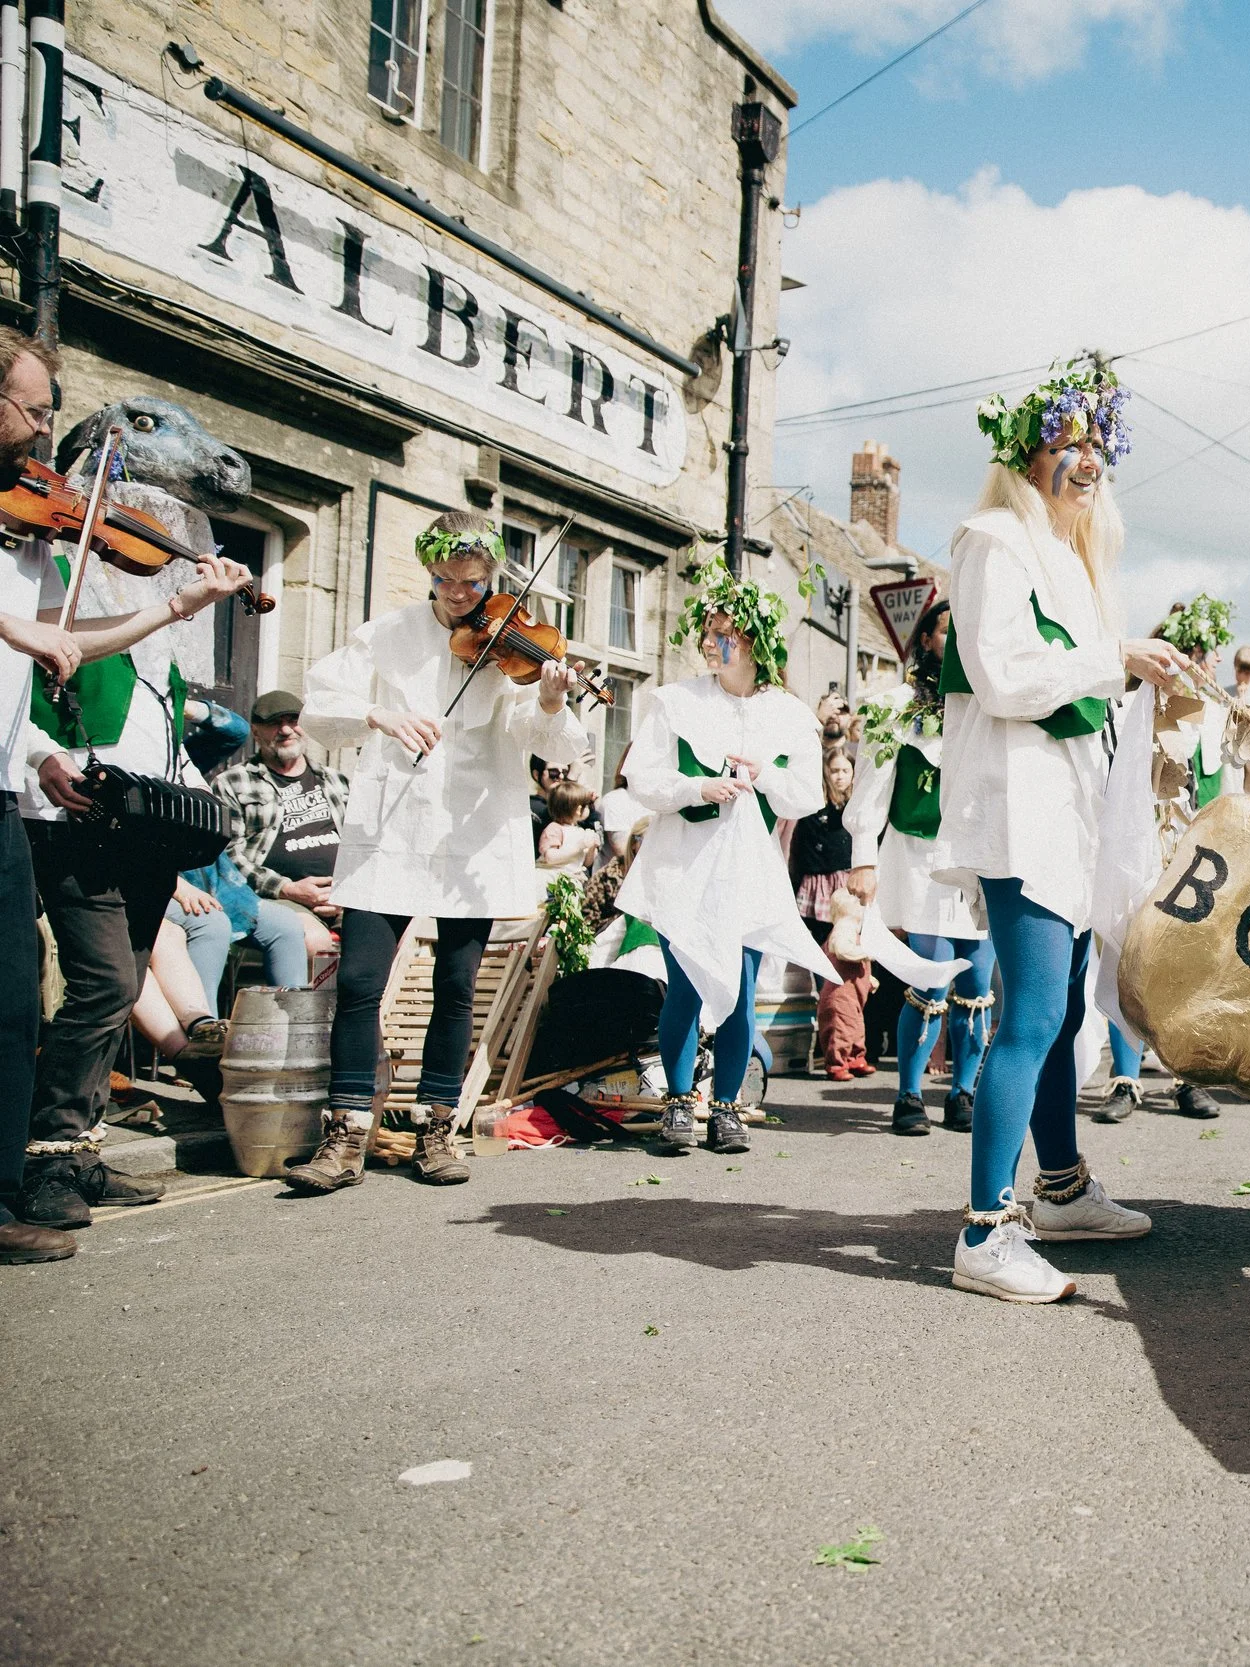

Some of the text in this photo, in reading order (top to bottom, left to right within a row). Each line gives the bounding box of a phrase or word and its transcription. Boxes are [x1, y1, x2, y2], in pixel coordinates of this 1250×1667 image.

[197, 164, 670, 457] ALBERT
[884, 589, 923, 609] GIVE
[893, 610, 917, 623] WAY
[282, 790, 327, 814] RINCE
